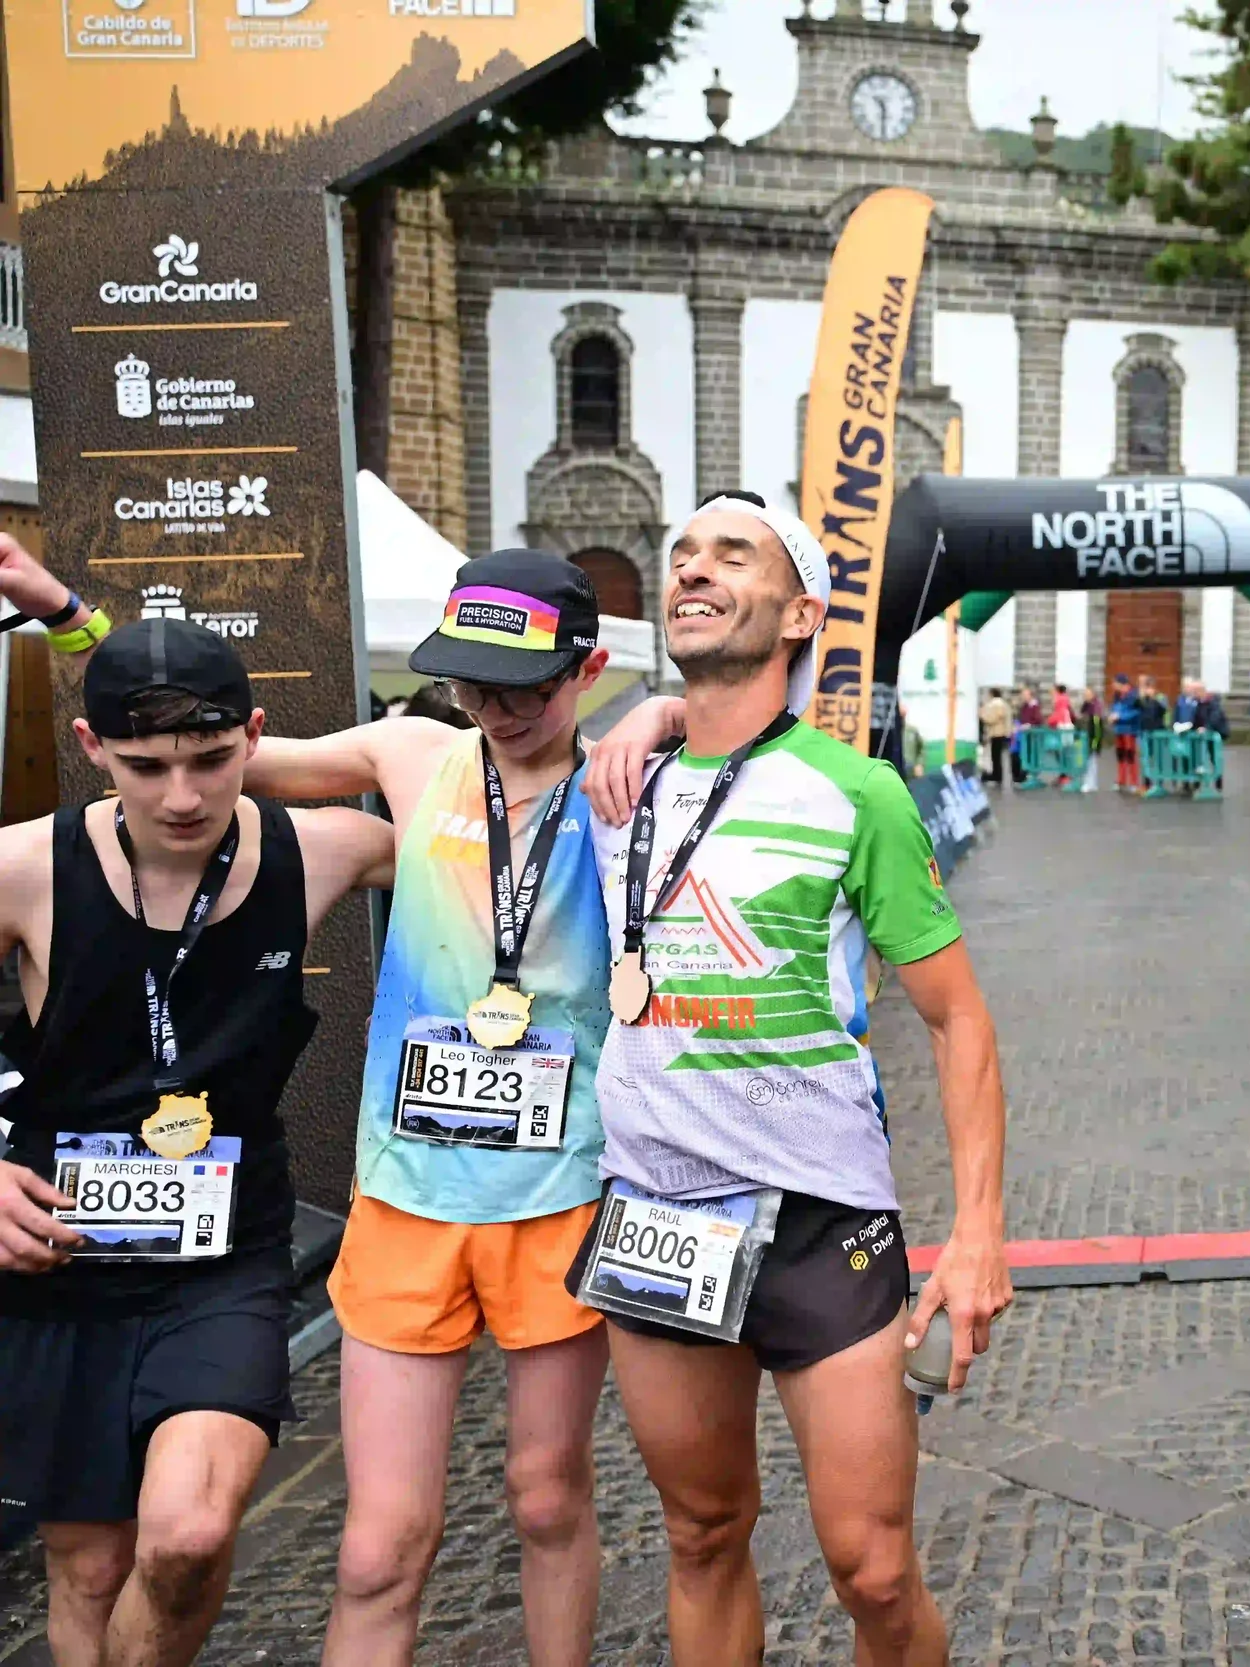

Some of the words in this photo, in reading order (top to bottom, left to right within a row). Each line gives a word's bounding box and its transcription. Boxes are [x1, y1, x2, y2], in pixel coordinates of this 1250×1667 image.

[84, 15, 147, 31] Cabildo
[150, 16, 172, 31] de
[77, 31, 116, 47] Gran
[120, 31, 183, 46] Canaria
[248, 35, 325, 48] DEPORTES
[867, 275, 907, 420] CANARIA
[843, 311, 875, 410] GRAN
[155, 377, 236, 394] Gobierno
[157, 396, 178, 410] de
[179, 393, 255, 410] Canarias
[166, 477, 224, 500] Islas
[1096, 483, 1181, 512] THE
[114, 496, 226, 520] Canarias
[1031, 510, 1182, 549] NORTH
[1077, 545, 1181, 577] FACE
[459, 617, 474, 625] FUEL
[480, 618, 522, 631] HYDRATION
[461, 606, 525, 624] PRECISION
[645, 943, 718, 956] RGAS
[667, 960, 734, 970] Canaria
[488, 1011, 510, 1021] TRANS
[521, 1032, 540, 1042] RAN
[441, 1048, 465, 1062] Leo
[470, 1050, 517, 1067] Togher
[426, 1064, 524, 1103] 8123
[165, 1119, 190, 1131] TRANS
[94, 1163, 178, 1176] MARCHESI
[79, 1179, 185, 1213] 8033
[648, 1207, 682, 1226] RAUL
[858, 1212, 890, 1242] Digital
[618, 1221, 699, 1269] 8006
[871, 1232, 895, 1256] DMP
